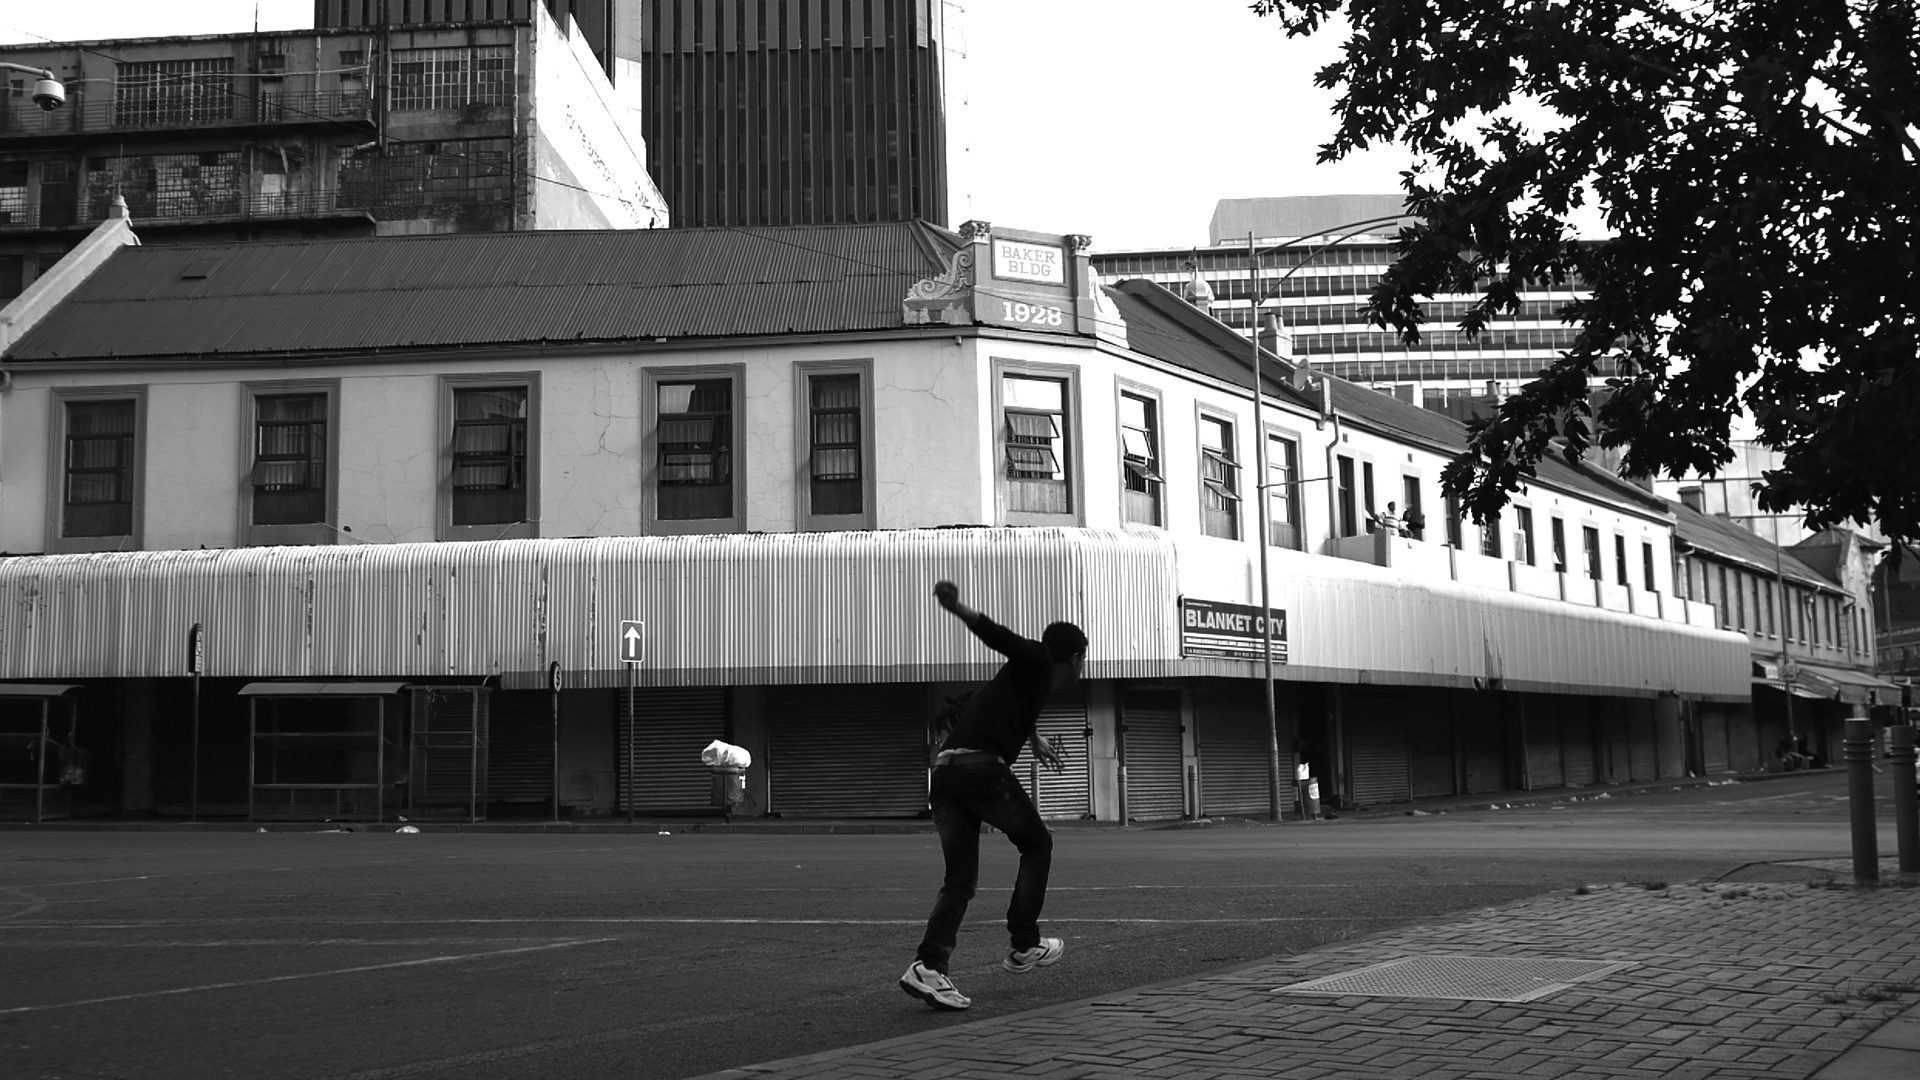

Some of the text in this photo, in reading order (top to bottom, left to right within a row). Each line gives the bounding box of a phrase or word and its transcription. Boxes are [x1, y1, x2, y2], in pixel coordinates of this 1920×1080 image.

[1002, 246, 1056, 264] BAKER
[1008, 261, 1051, 276] BLDG
[1003, 302, 1062, 326] 1928
[1186, 609, 1284, 636] BLANKET CTY
